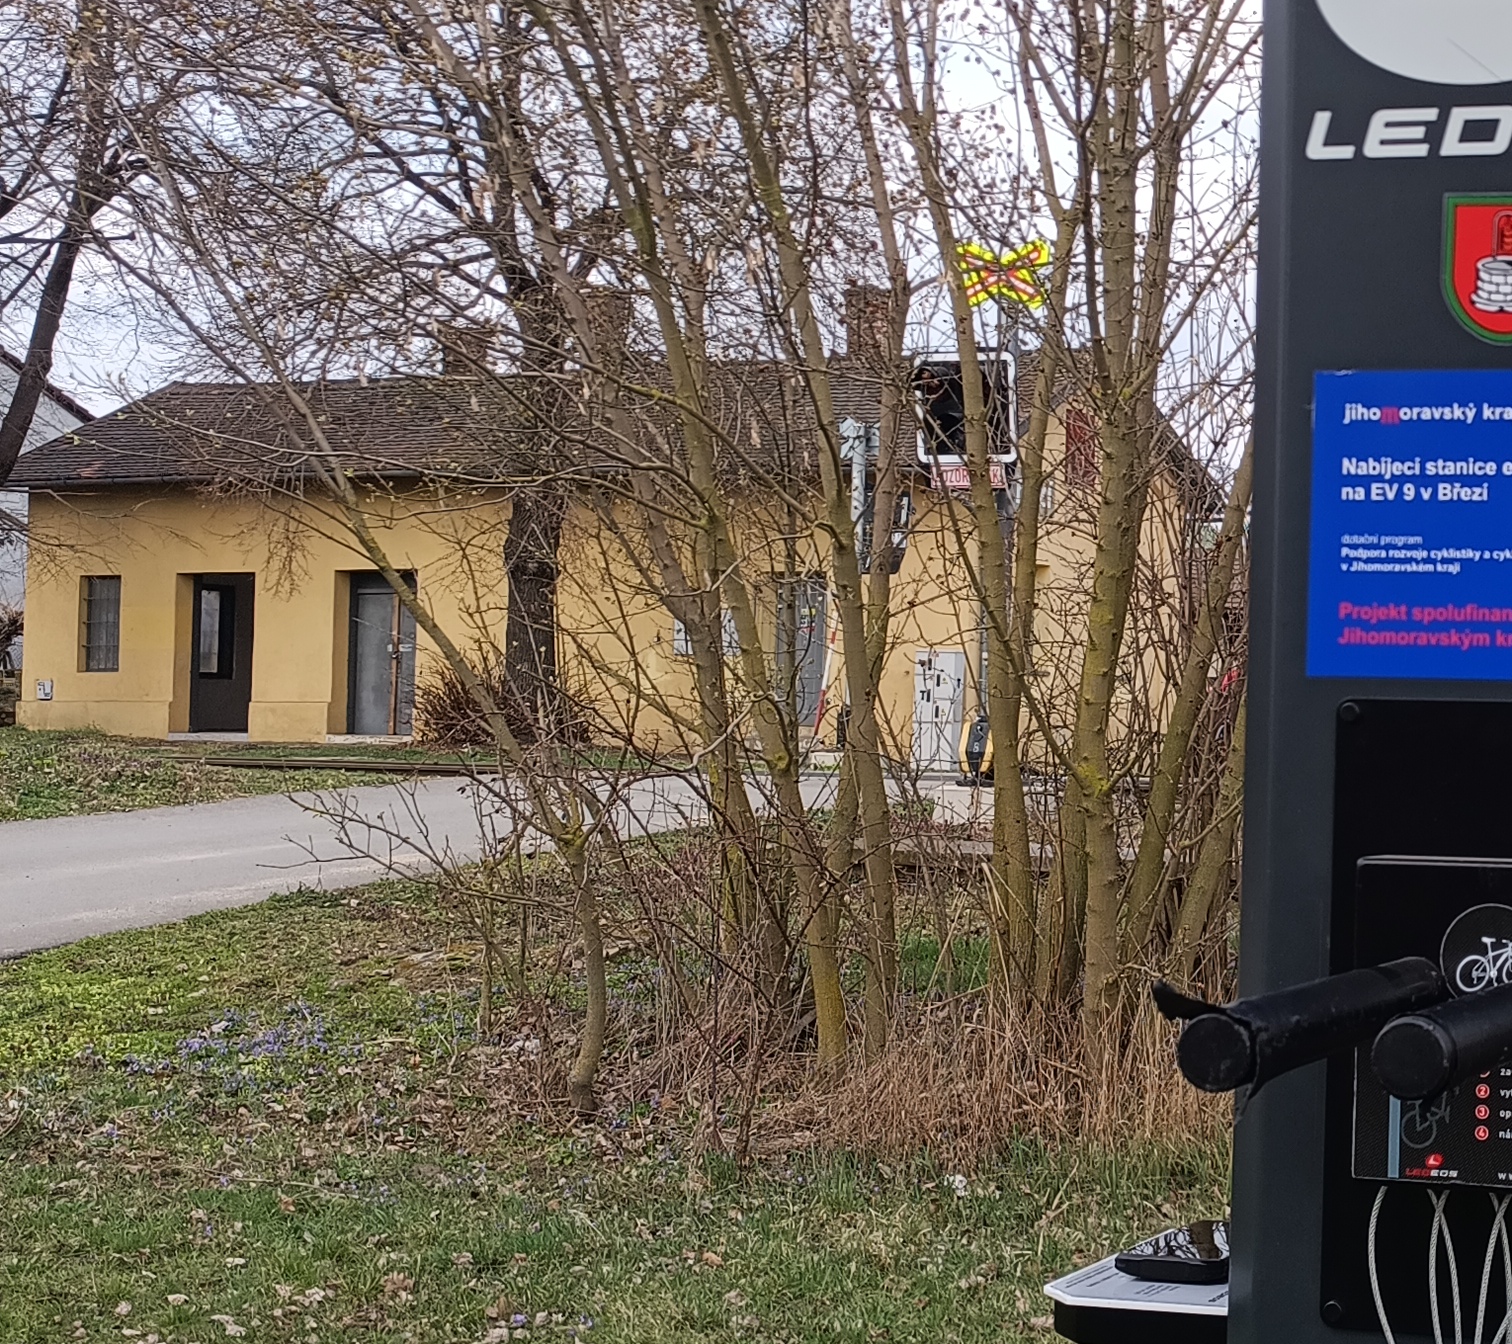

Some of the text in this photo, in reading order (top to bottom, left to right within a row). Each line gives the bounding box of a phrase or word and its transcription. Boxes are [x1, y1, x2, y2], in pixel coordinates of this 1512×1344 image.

[1342, 402, 1476, 425] jihomoravský
[1341, 456, 1421, 479] Nabíjecí
[1425, 457, 1497, 476] stanice
[1341, 482, 1488, 501] na EV 9 v Březí
[1380, 535, 1423, 547] program
[1341, 547, 1387, 559] Podpora
[1388, 548, 1428, 560] rozvoje
[1430, 548, 1482, 561] cyklistiky
[1483, 551, 1490, 559] a
[1341, 561, 1461, 574] v Jihomoravském kraji
[1338, 602, 1407, 624] Projekt
[1338, 627, 1490, 650] Jihomoravským
